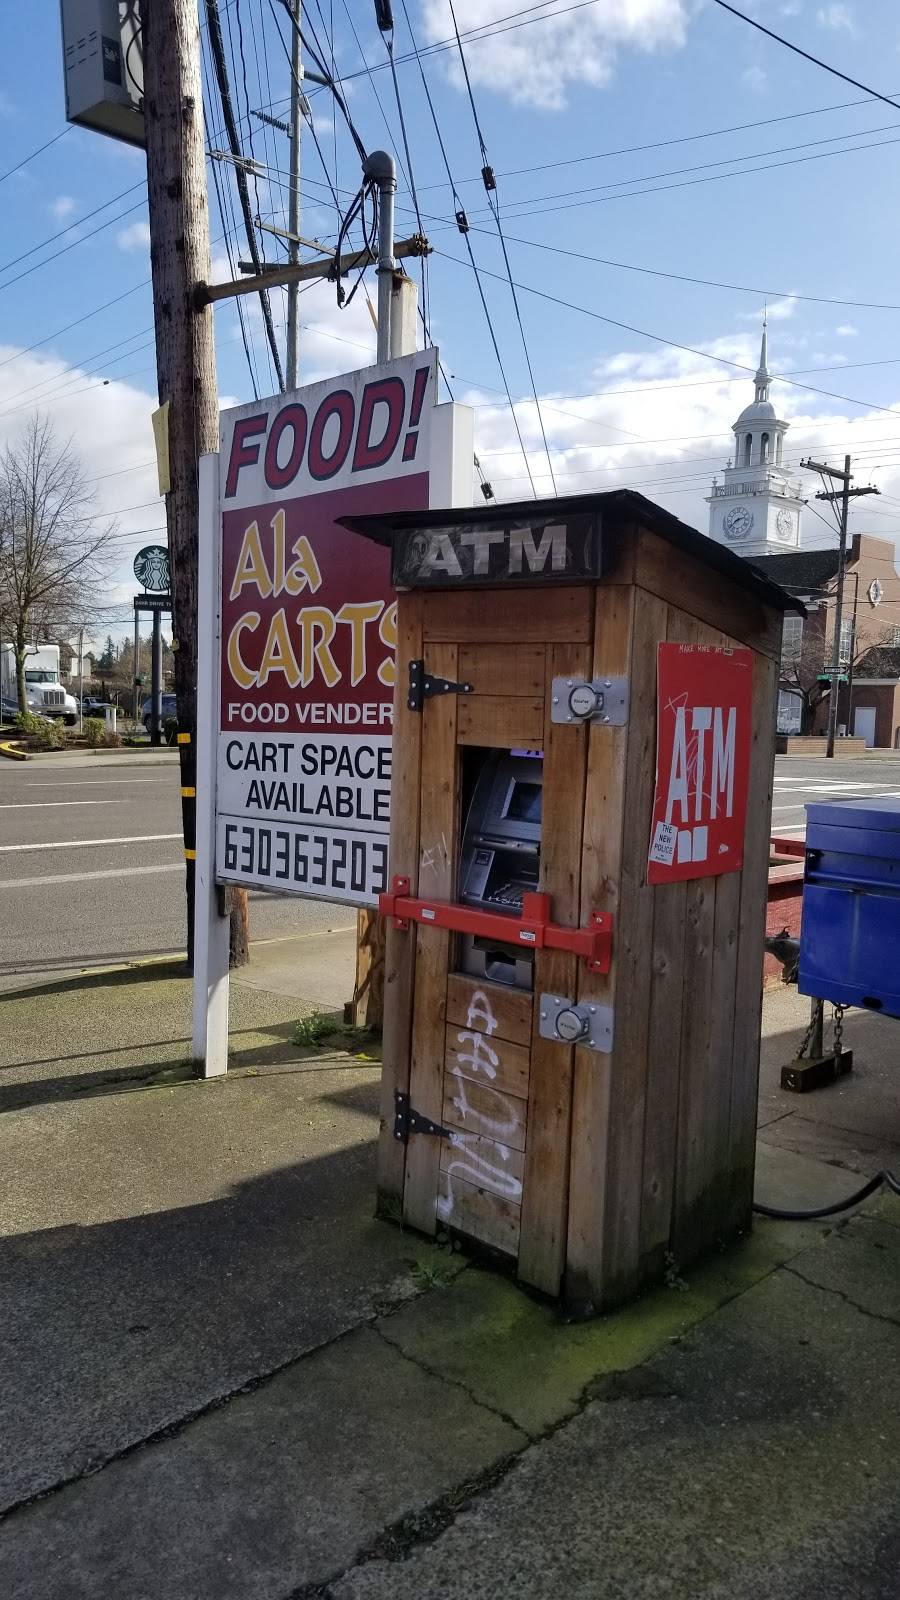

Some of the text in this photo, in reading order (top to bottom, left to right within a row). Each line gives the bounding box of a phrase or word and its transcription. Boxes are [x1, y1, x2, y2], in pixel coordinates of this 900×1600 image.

[225, 365, 431, 499] FOOD!
[229, 508, 322, 601] Ala
[417, 525, 567, 577] ATM
[227, 702, 394, 725] FOOD VENDER
[226, 740, 392, 780] CART SPACE
[665, 706, 737, 825] ATM
[245, 779, 391, 822] AVAILABLE
[658, 834, 672, 844] NEW
[662, 824, 673, 834] THE
